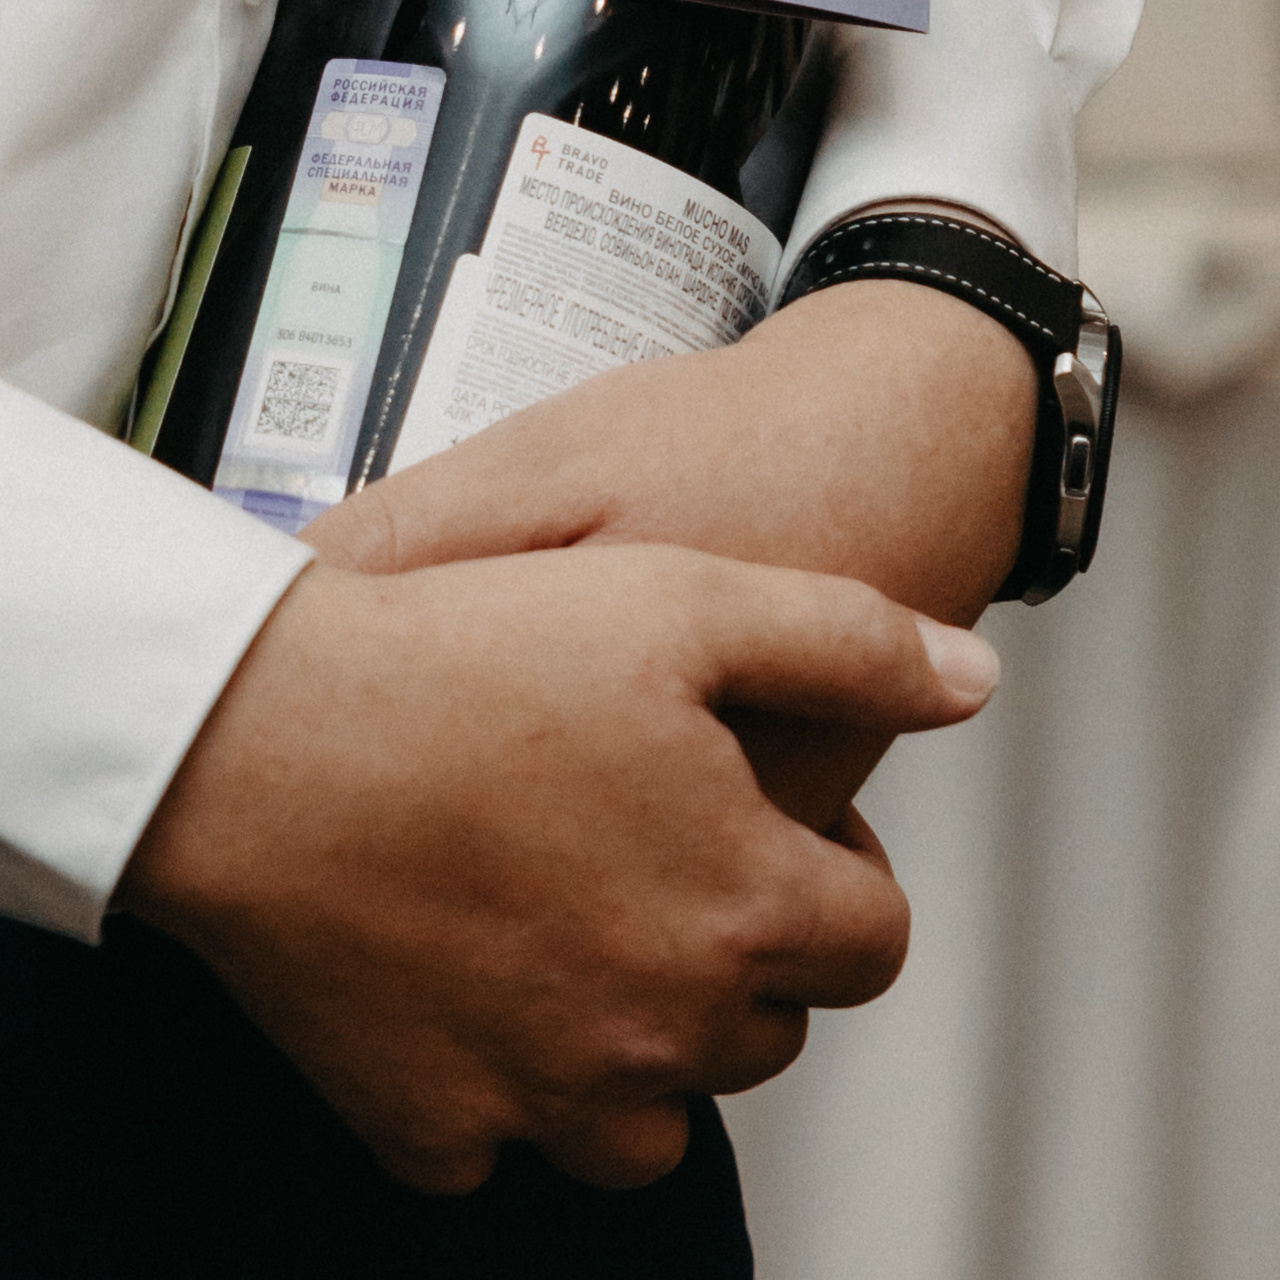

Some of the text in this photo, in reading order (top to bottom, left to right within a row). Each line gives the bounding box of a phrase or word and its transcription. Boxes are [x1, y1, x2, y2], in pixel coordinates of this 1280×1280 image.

[333, 78, 428, 98] РОССИЙСКАЯ
[330, 91, 425, 110] ФЕДЕРАЦИЯ
[311, 153, 413, 174] ФЕДЕРАЛЬНАЯ
[561, 143, 609, 170] BRAVO
[307, 166, 409, 188] СПЕЦИАЛЬНАЯ
[558, 157, 605, 184] TRADE
[328, 181, 376, 197] МАРКА
[518, 174, 561, 206] МЕСТО
[560, 189, 655, 245] ПРОИСХОЖДЕНИЯ
[608, 188, 653, 219] ВИНО
[655, 210, 701, 244] БЕЛОЕ
[702, 236, 737, 269] СУХОЕ
[682, 198, 751, 256] MUCHO MAS
[600, 232, 657, 273] СОВИНЬОН
[311, 280, 341, 294] ВИНА
